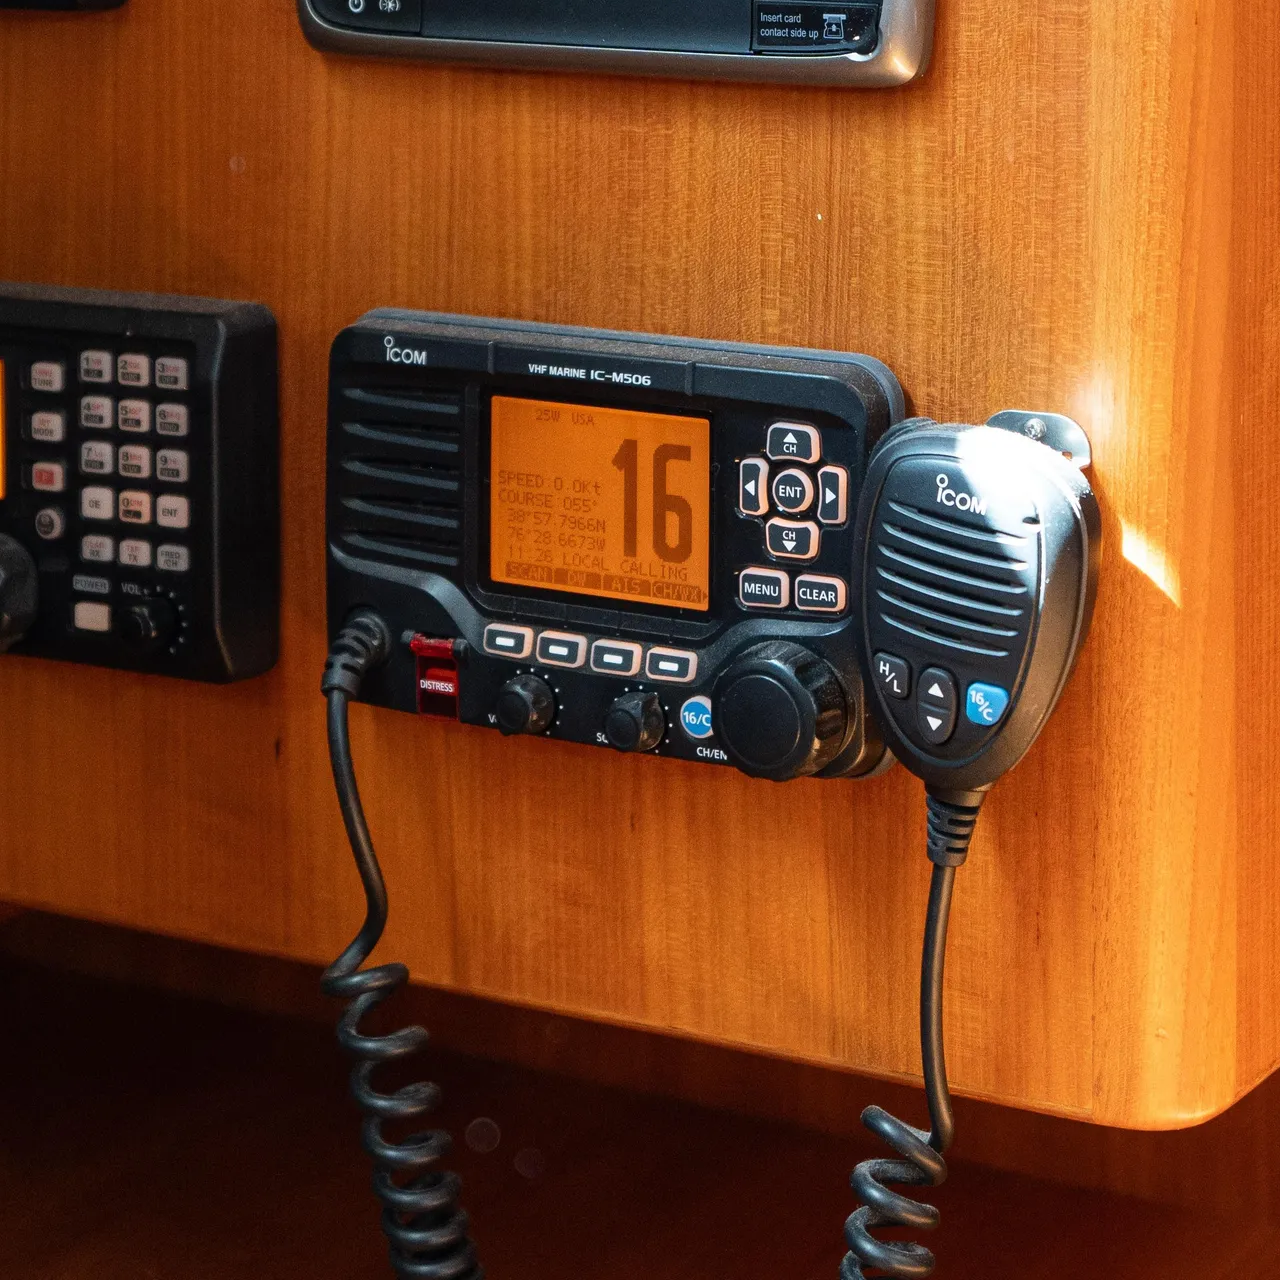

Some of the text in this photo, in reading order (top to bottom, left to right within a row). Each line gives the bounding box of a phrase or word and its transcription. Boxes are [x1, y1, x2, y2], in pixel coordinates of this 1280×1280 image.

[761, 13, 802, 24] Insert card
[760, 27, 819, 40] contact side up
[120, 360, 127, 370] 2
[528, 363, 652, 386] VHF MARINE IC-M506
[120, 406, 128, 416] 5
[158, 410, 166, 420] 6
[535, 408, 595, 427] 25W USA
[783, 443, 797, 453] CH
[122, 452, 130, 462] 8
[160, 456, 168, 466] 9
[498, 470, 544, 489] SPEED
[778, 485, 802, 498] ENT
[121, 497, 129, 508] 0
[498, 488, 553, 509] COURSE
[611, 438, 693, 564] 16
[162, 509, 178, 518] ENT
[782, 530, 796, 540] CH
[128, 553, 138, 563] TX
[563, 553, 609, 572] LOCAL
[621, 560, 688, 582] CALLING
[121, 583, 141, 595] VOL
[612, 579, 641, 594] AIS
[744, 582, 779, 597] MENU
[799, 588, 836, 602] CLEAR
[879, 661, 901, 693] H/L
[420, 680, 453, 693] DISTRESS
[970, 689, 993, 721] 16/C
[683, 711, 711, 727] 16/C
[696, 747, 727, 761] CH/EN
